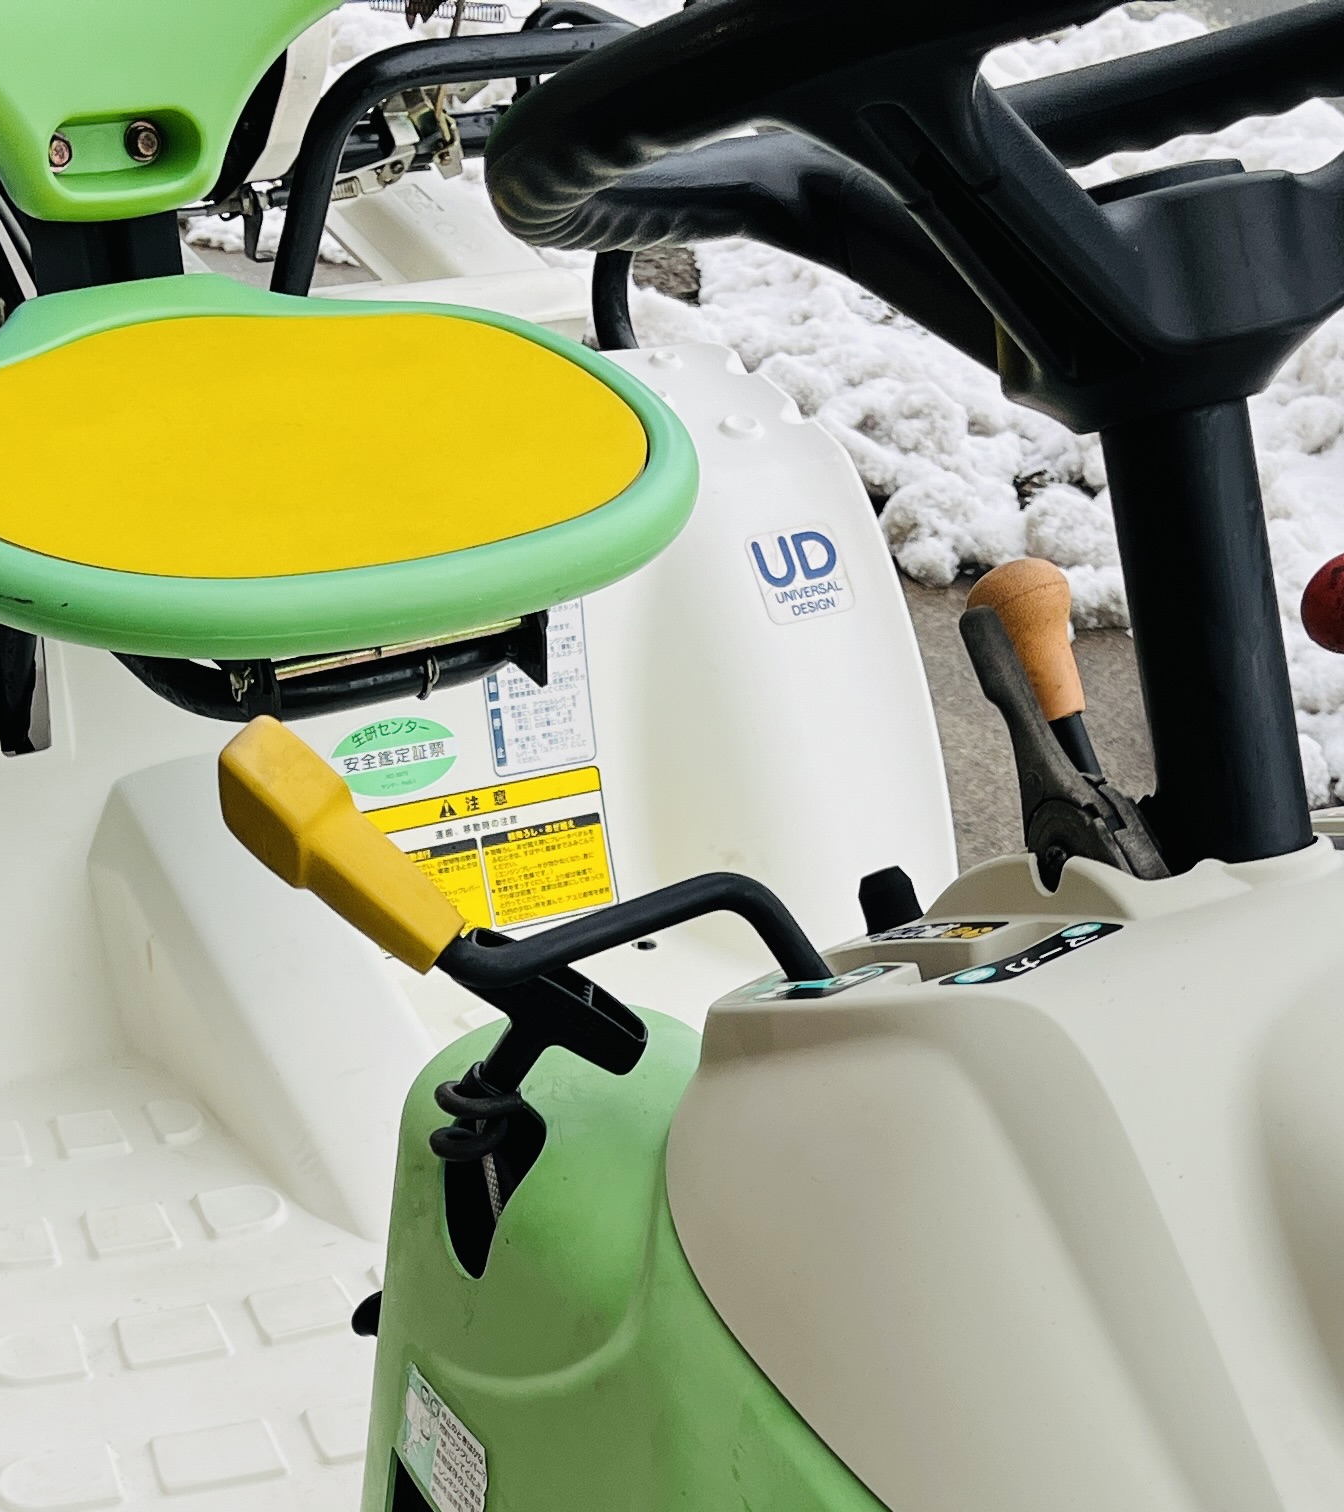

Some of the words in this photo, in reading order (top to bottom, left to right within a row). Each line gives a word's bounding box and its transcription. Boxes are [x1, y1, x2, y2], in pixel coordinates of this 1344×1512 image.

[751, 531, 837, 588] UD
[775, 581, 843, 604] UNIVERSAL
[791, 598, 836, 617] DESIGN
[351, 719, 431, 749] 生研センター
[343, 740, 446, 775] 安全鑑定証票
[465, 789, 508, 812] 注意
